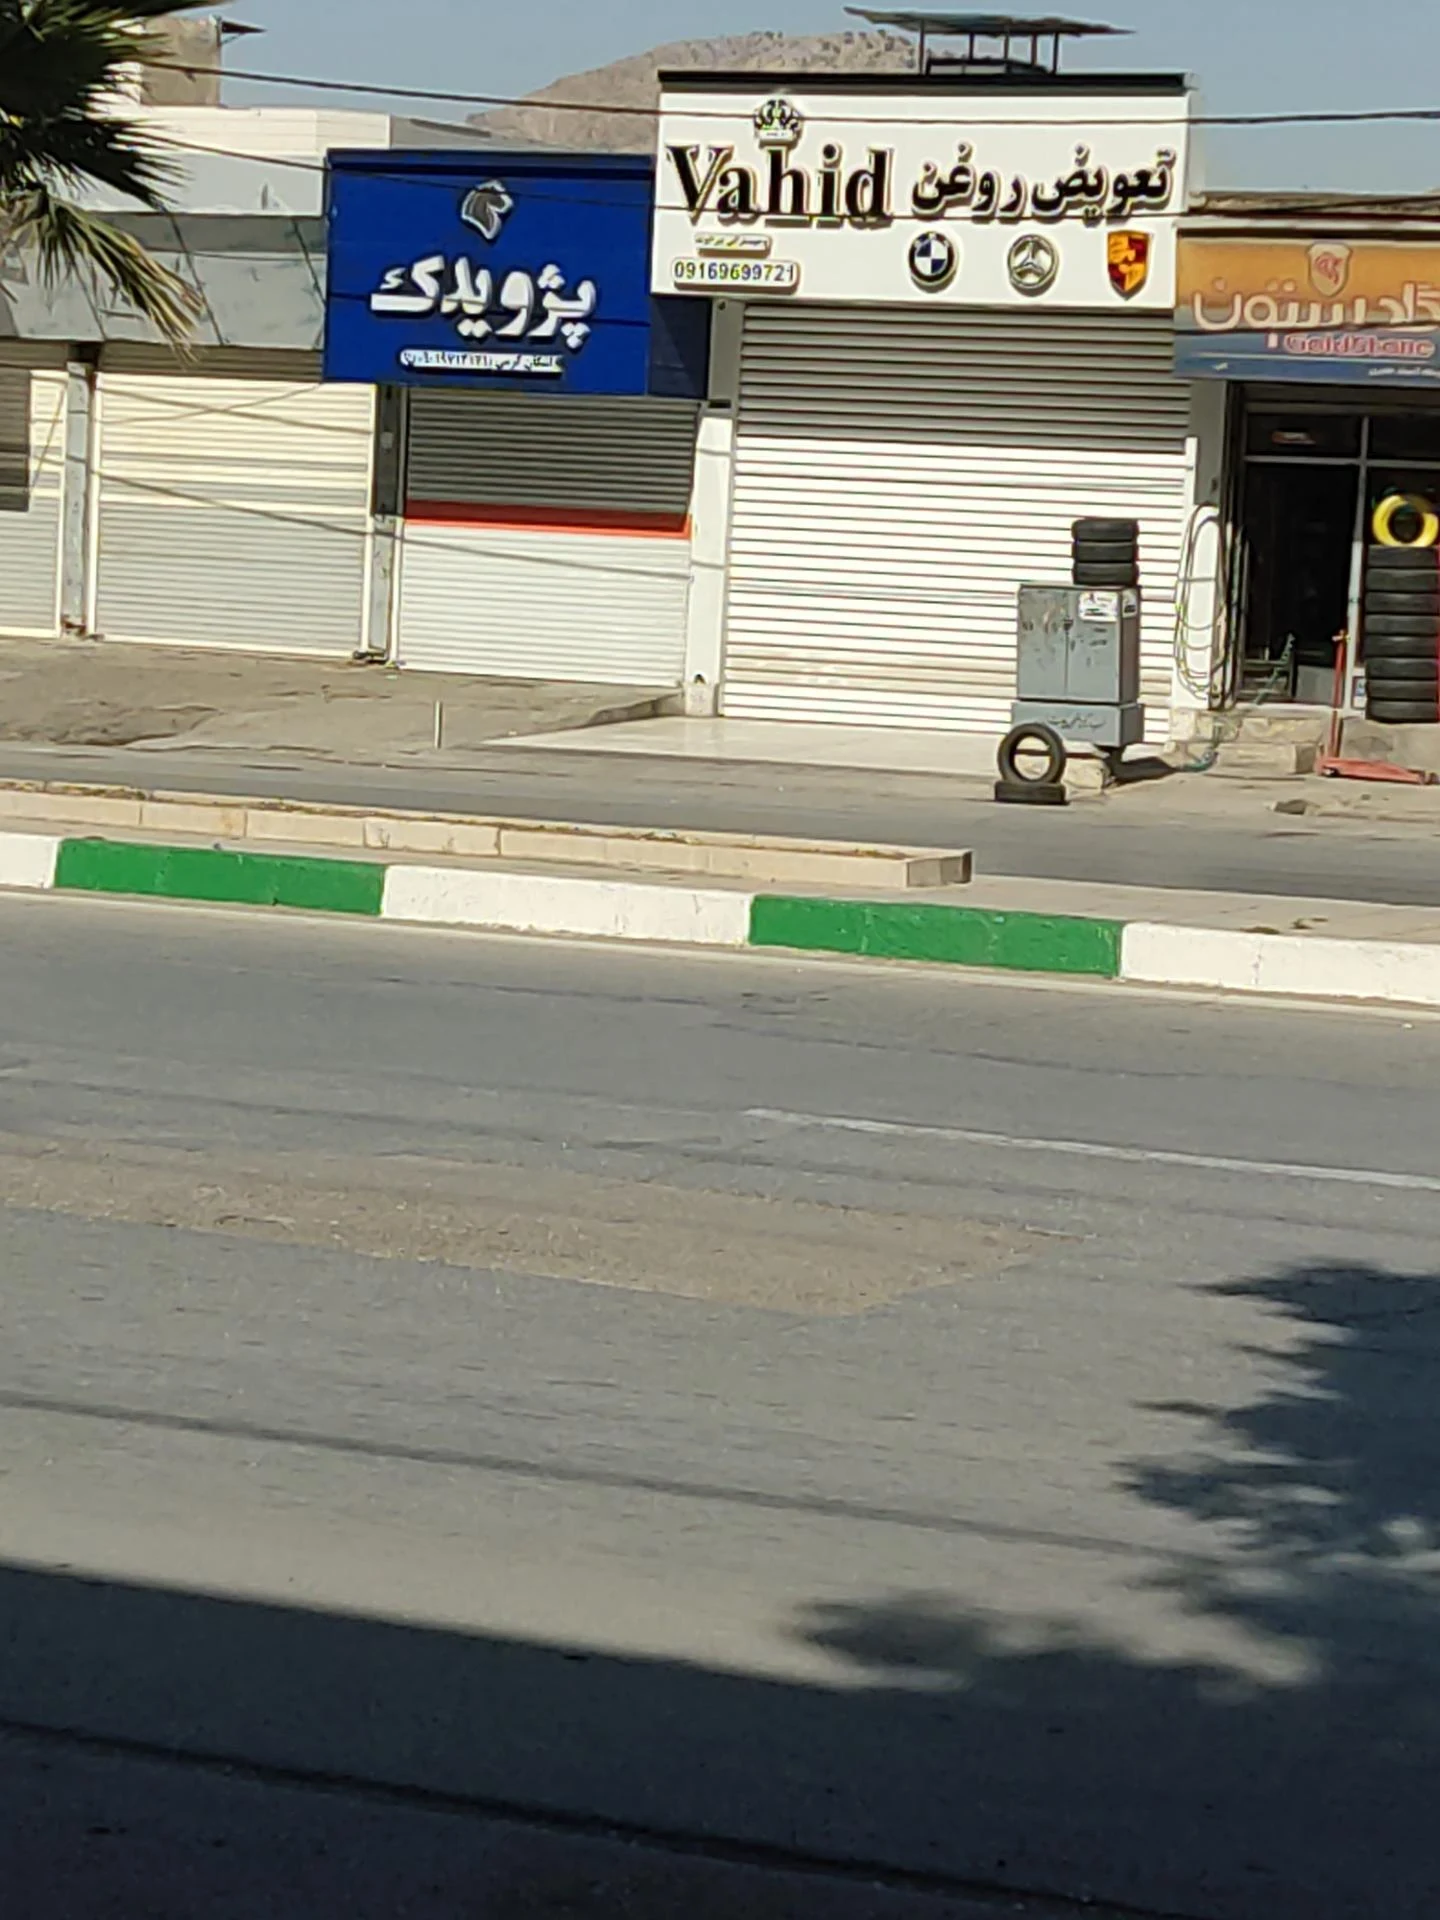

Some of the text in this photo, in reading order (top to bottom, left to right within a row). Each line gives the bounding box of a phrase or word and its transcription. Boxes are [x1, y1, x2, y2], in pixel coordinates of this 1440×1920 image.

[665, 142, 893, 223] Vahid
[912, 143, 1178, 220] تعویض روغن
[673, 260, 794, 282] 09169699721
